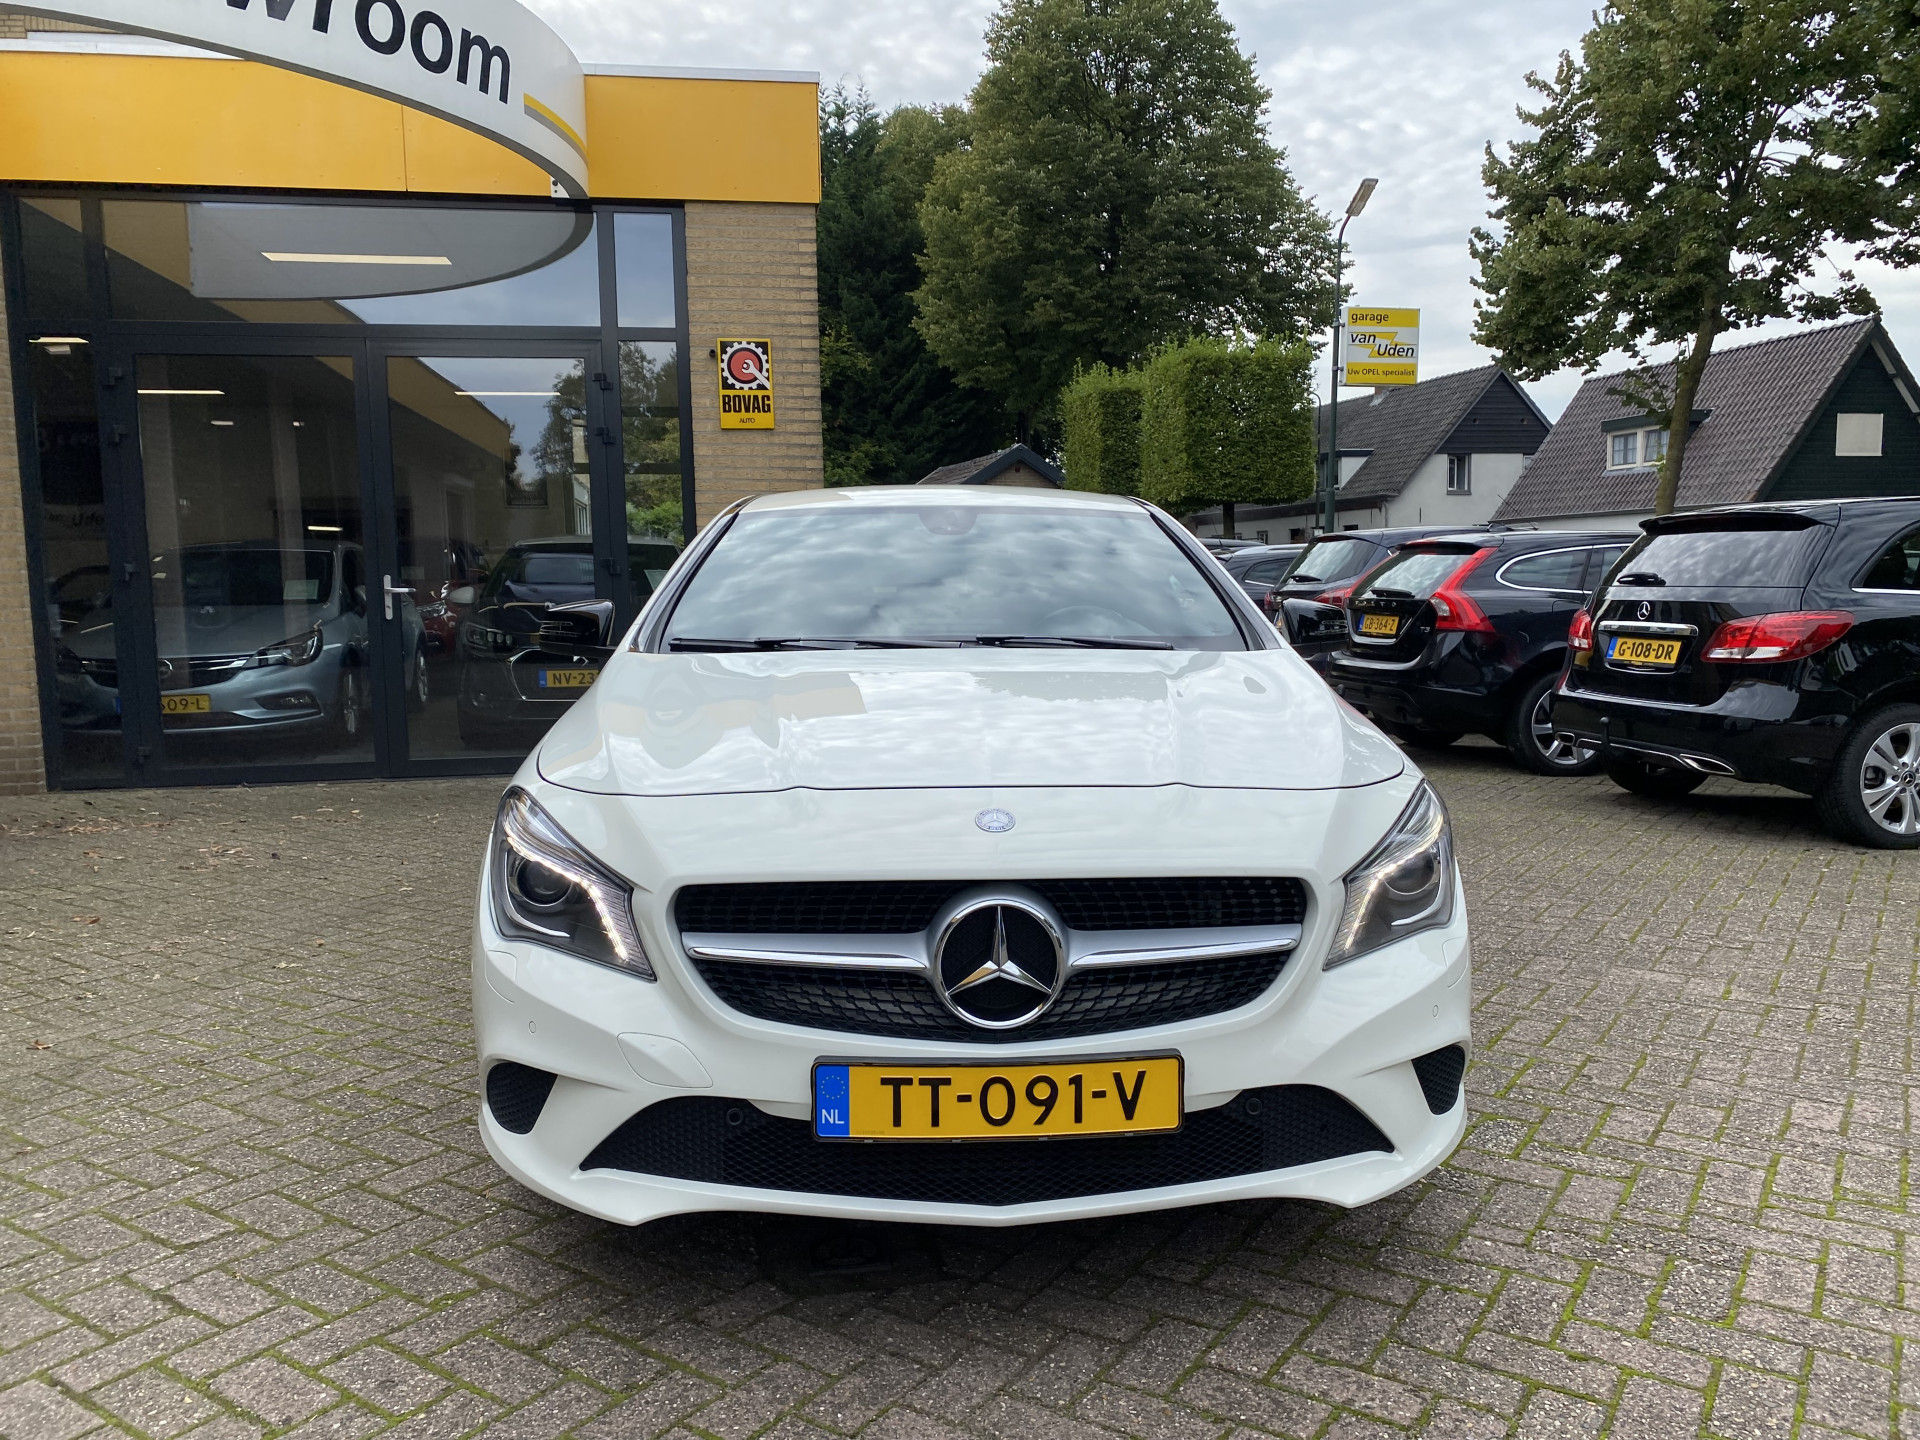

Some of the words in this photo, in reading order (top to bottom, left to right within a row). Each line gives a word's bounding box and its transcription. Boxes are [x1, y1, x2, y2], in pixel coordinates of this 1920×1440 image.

[1351, 313, 1389, 324] garage
[1350, 333, 1376, 344] van
[1377, 343, 1415, 357] Uden
[1347, 368, 1361, 376] Uw
[1361, 368, 1380, 376] OPEL
[1382, 368, 1415, 377] specialist
[722, 394, 771, 414] BOVAG
[1364, 617, 1396, 632] GB-364-Z
[1618, 641, 1674, 660] G-108-DR
[552, 672, 600, 685] NV-23
[880, 1070, 1147, 1127] TT-091-V
[821, 1109, 845, 1124] NL
